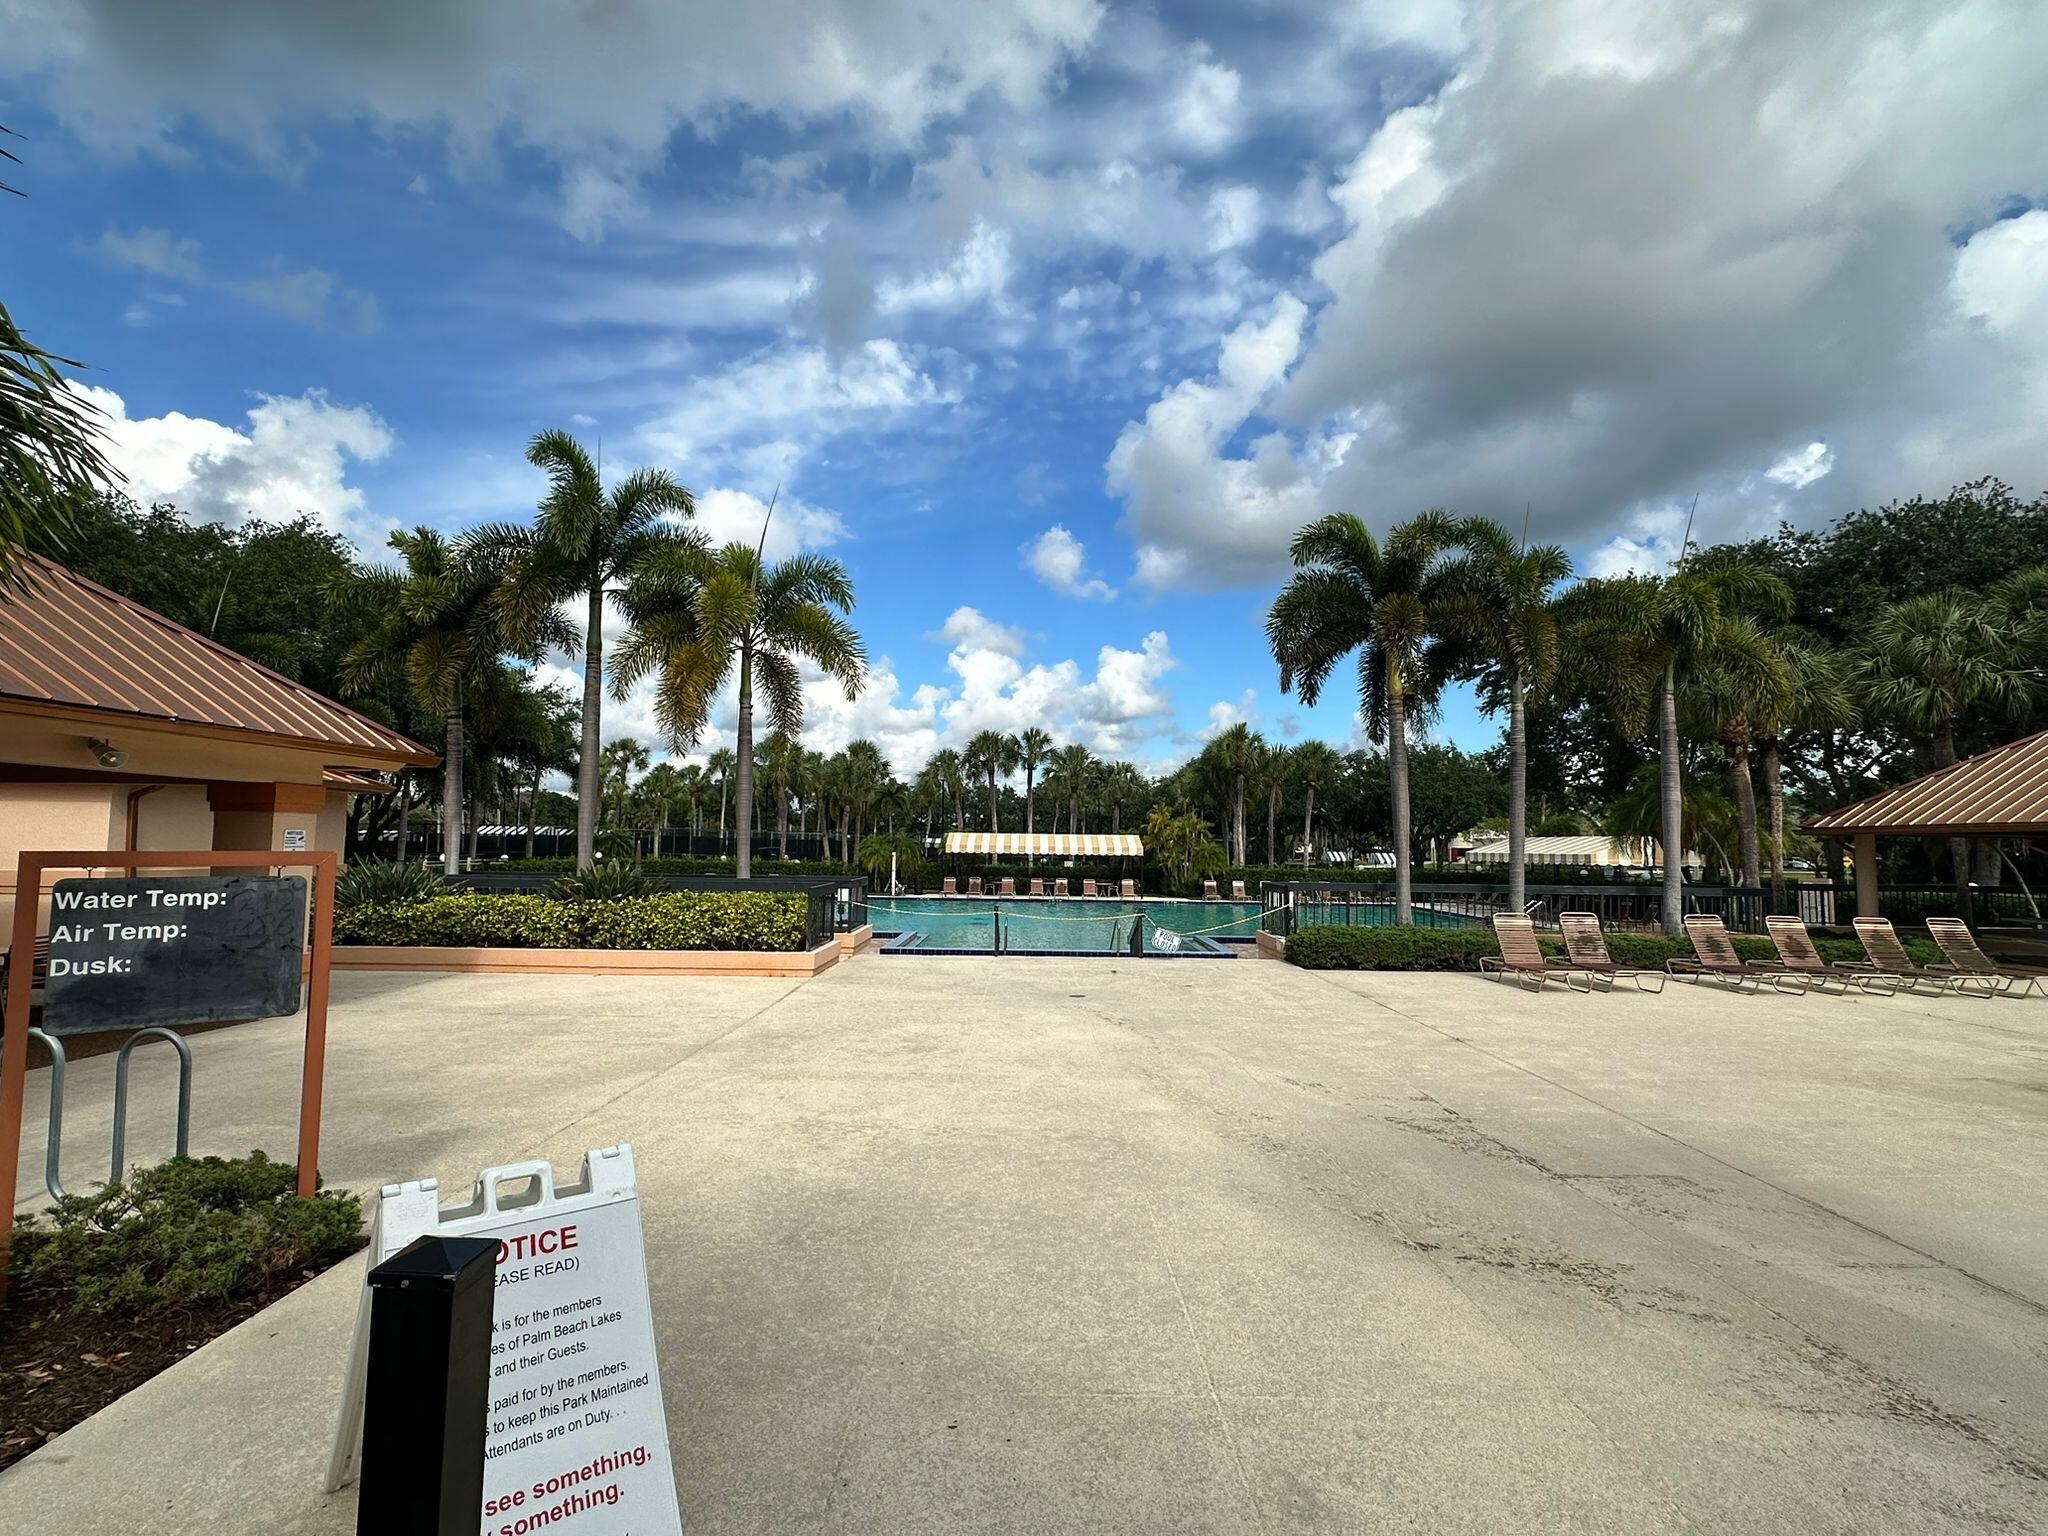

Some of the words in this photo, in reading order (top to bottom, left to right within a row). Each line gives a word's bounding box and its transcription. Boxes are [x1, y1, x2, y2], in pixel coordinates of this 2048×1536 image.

[54, 891, 138, 910] Water
[146, 889, 227, 910] Temp:
[50, 924, 95, 943] Air
[103, 922, 188, 943] Temp:
[1160, 930, 1175, 944] POOL
[49, 956, 132, 977] Dusk:
[496, 1225, 578, 1266] OTICE
[534, 1256, 580, 1278] READ)
[502, 1319, 512, 1331] is
[514, 1314, 530, 1328] for
[532, 1309, 550, 1323] the
[552, 1296, 602, 1318] members
[508, 1335, 520, 1351] of
[522, 1330, 551, 1347] Palm
[554, 1318, 588, 1339] Beach
[590, 1310, 622, 1328] Lakes
[494, 1361, 516, 1377] and
[519, 1352, 545, 1371] their
[547, 1340, 590, 1361] Guests.
[493, 1421, 505, 1434] to
[508, 1411, 537, 1430] keep
[539, 1403, 560, 1420] this
[563, 1393, 589, 1412] Park
[591, 1372, 649, 1403] Maintained
[494, 1392, 519, 1413] paid
[522, 1387, 538, 1402] for
[540, 1383, 555, 1398] by
[557, 1377, 575, 1391] the
[577, 1360, 630, 1385] members.
[546, 1425, 565, 1440] are
[568, 1419, 582, 1433] on
[485, 1490, 525, 1517] see
[532, 1445, 652, 1500] something,
[499, 1484, 625, 1536] something.
